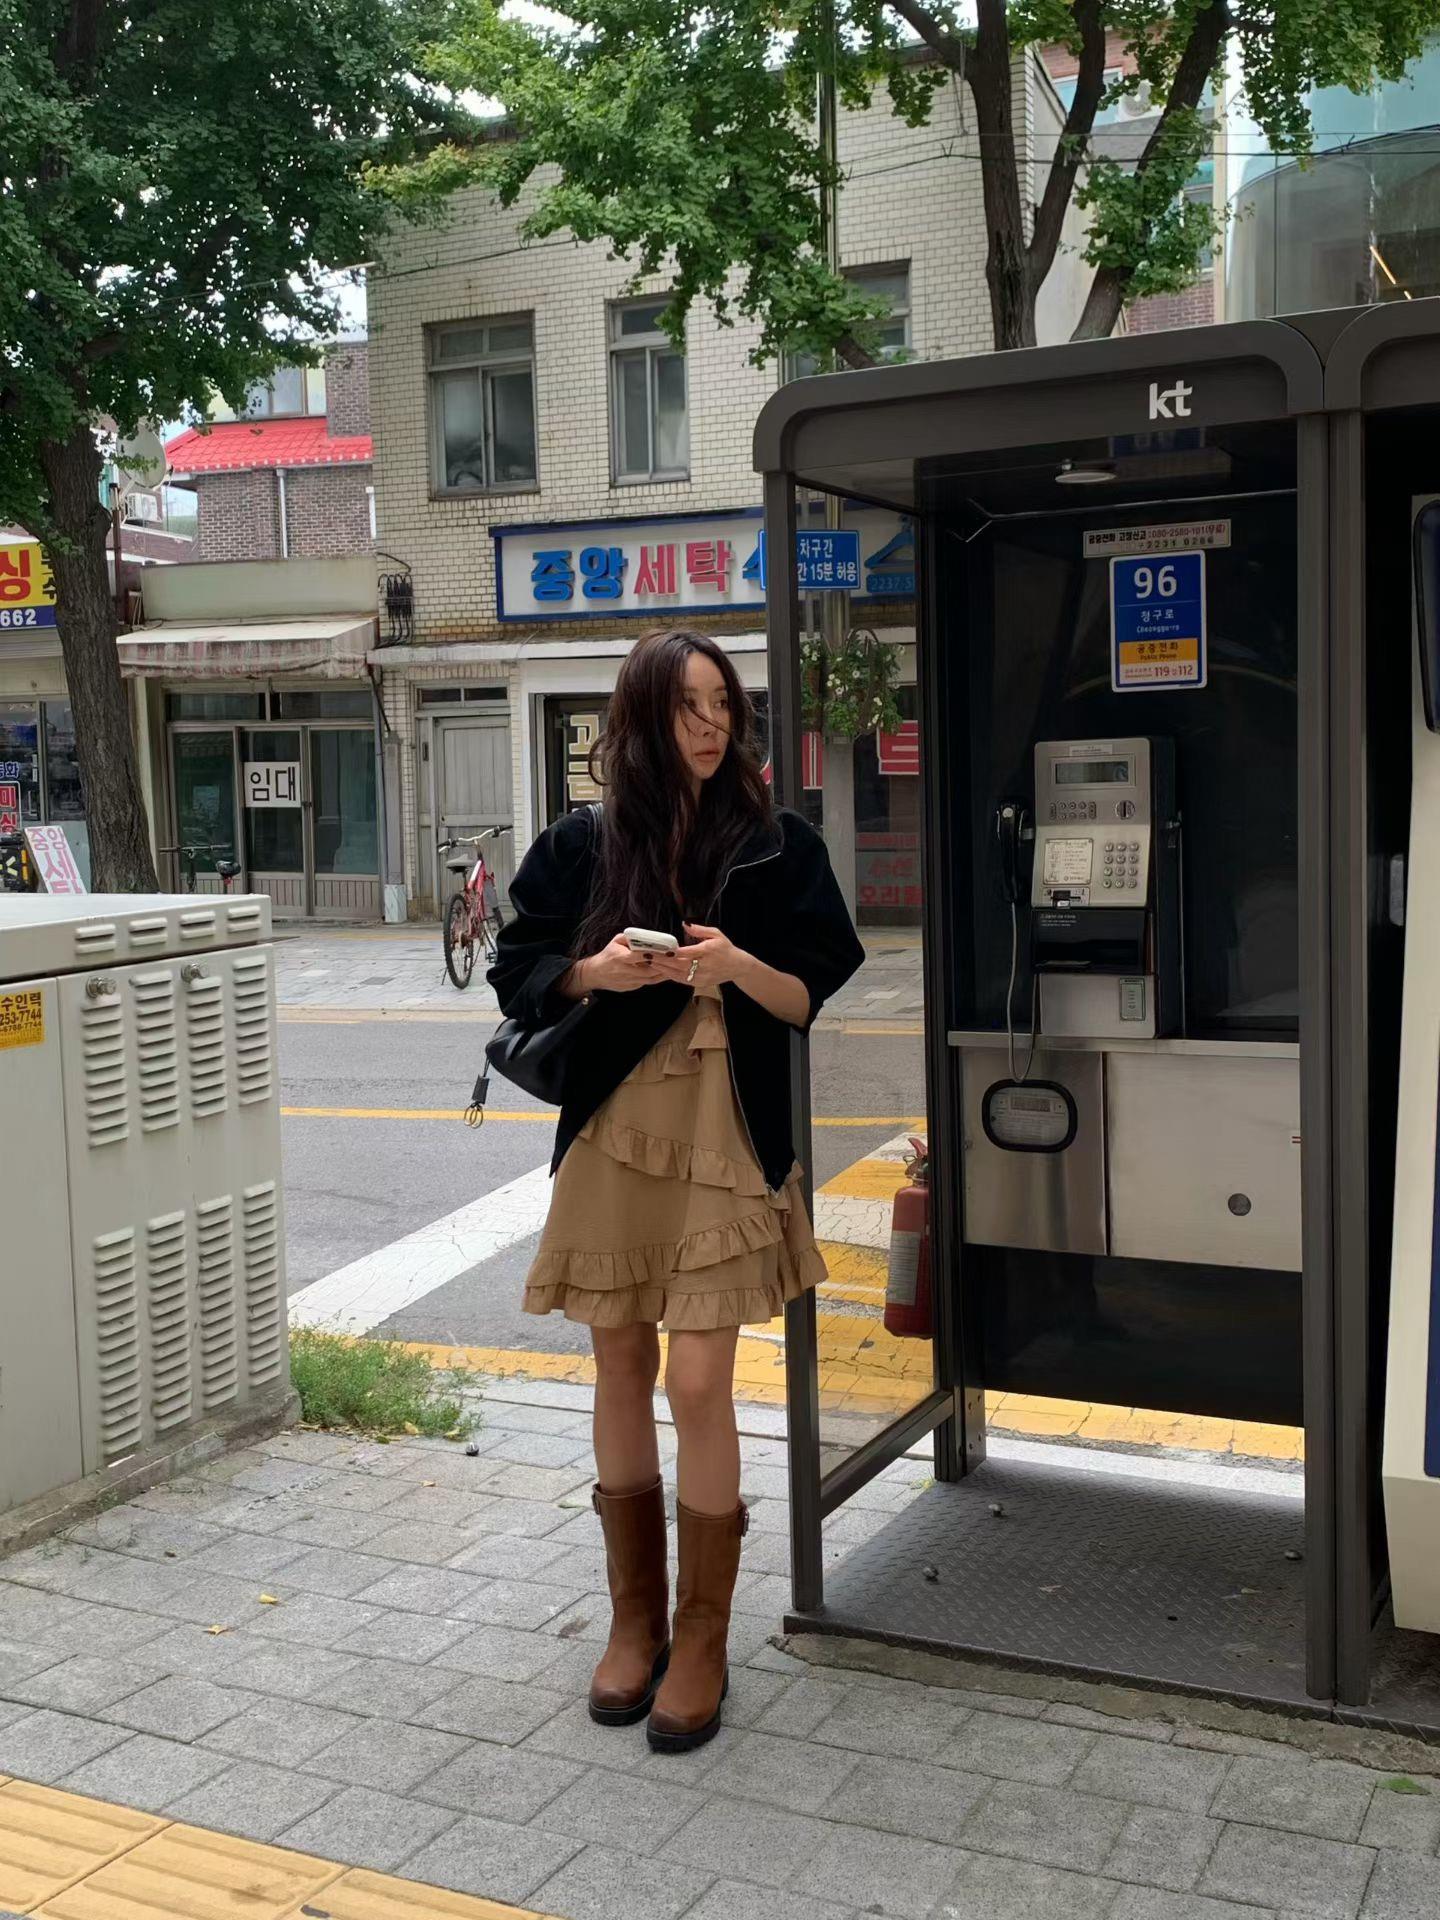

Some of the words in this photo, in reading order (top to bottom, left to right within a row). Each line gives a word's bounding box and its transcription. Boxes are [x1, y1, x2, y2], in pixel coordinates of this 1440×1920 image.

[1149, 380, 1193, 420] kt
[810, 561, 833, 582] 15분
[836, 562, 857, 582] 허용
[1134, 565, 1177, 599] 96
[1140, 608, 1175, 623] 청구로
[1154, 666, 1170, 677] 119
[1178, 664, 1193, 676] 112
[250, 766, 297, 801] 임대
